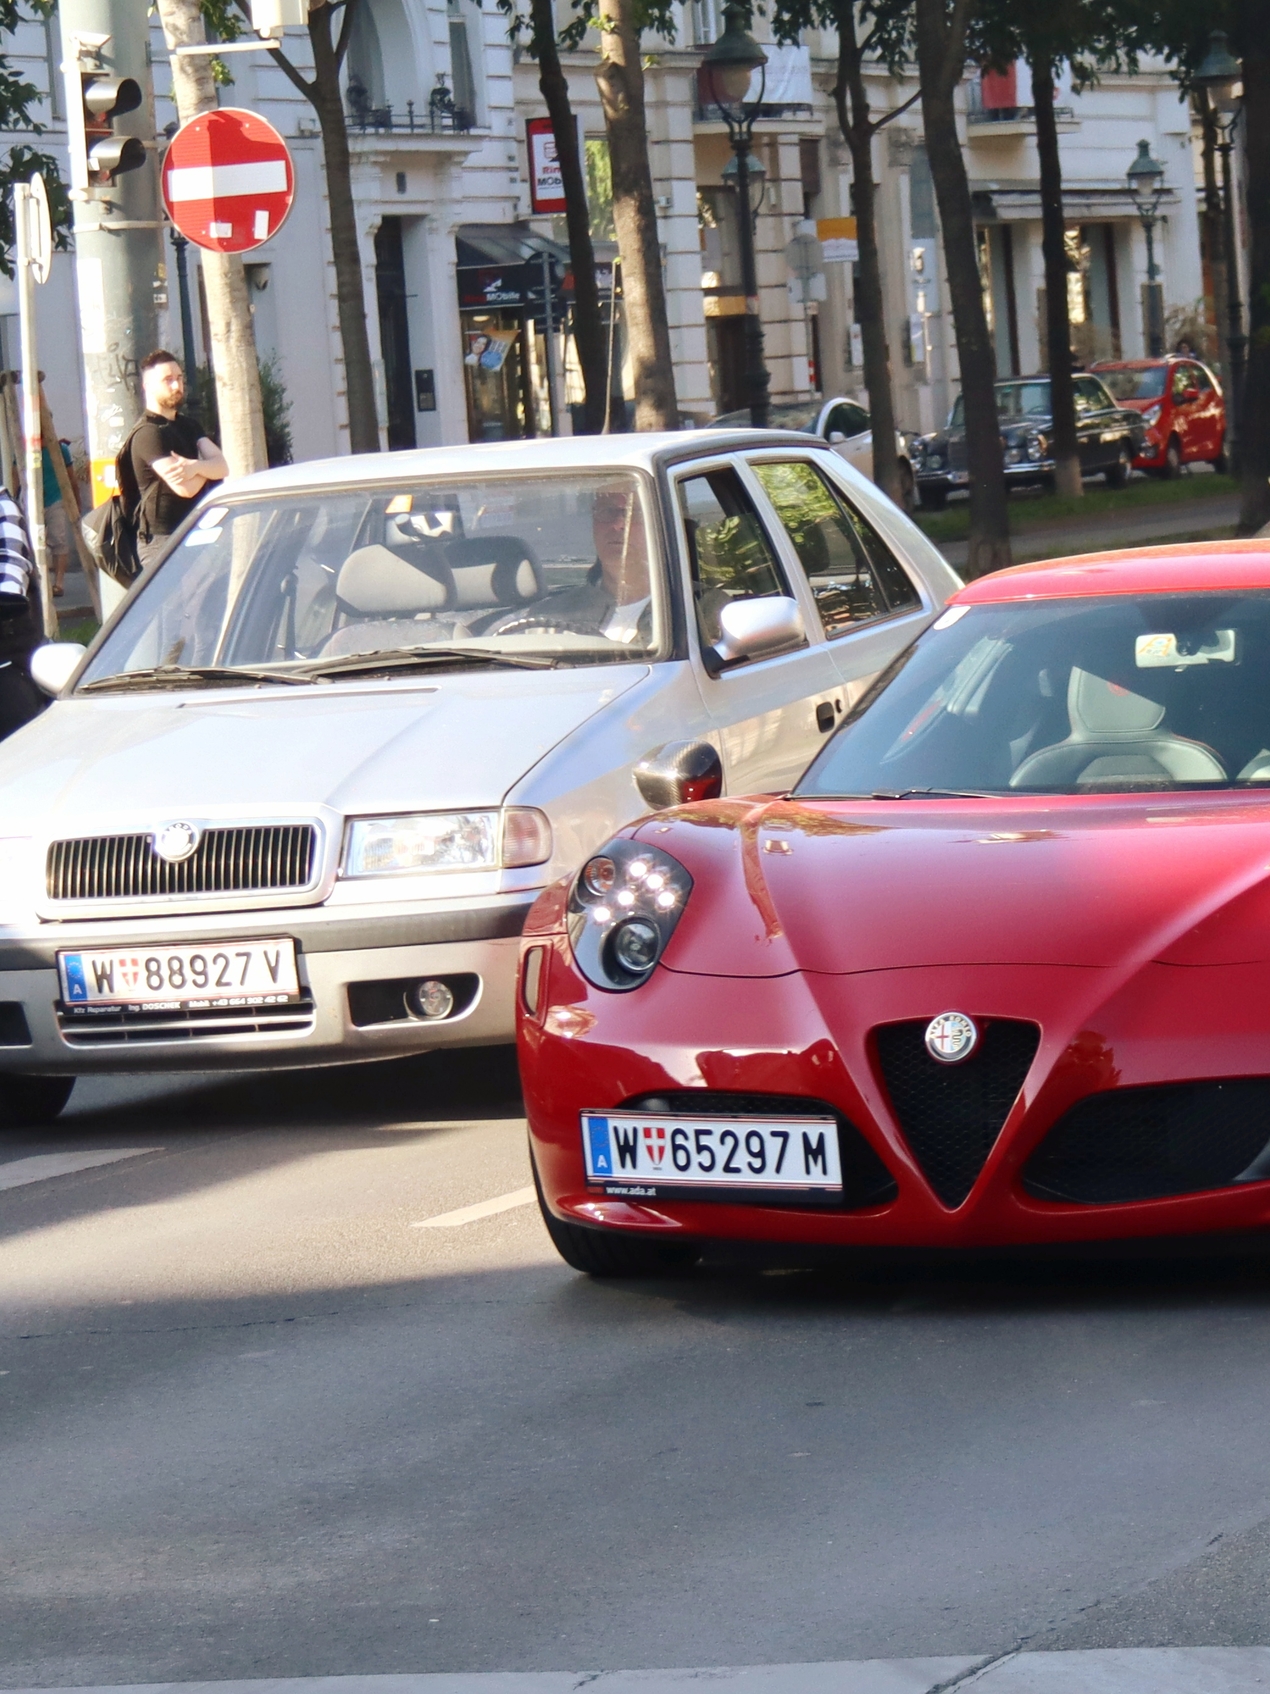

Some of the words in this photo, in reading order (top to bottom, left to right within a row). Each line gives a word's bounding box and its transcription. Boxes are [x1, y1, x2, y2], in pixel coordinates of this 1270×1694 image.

[91, 959, 114, 994] W
[145, 951, 253, 991] 88927
[263, 949, 280, 984] V
[73, 984, 83, 995] A
[949, 1015, 972, 1037] ROMEO
[613, 1125, 638, 1170] W
[671, 1127, 790, 1175] 65297
[802, 1131, 828, 1177] M
[597, 1154, 608, 1169] A
[606, 1185, 657, 1197] www.ada.at
